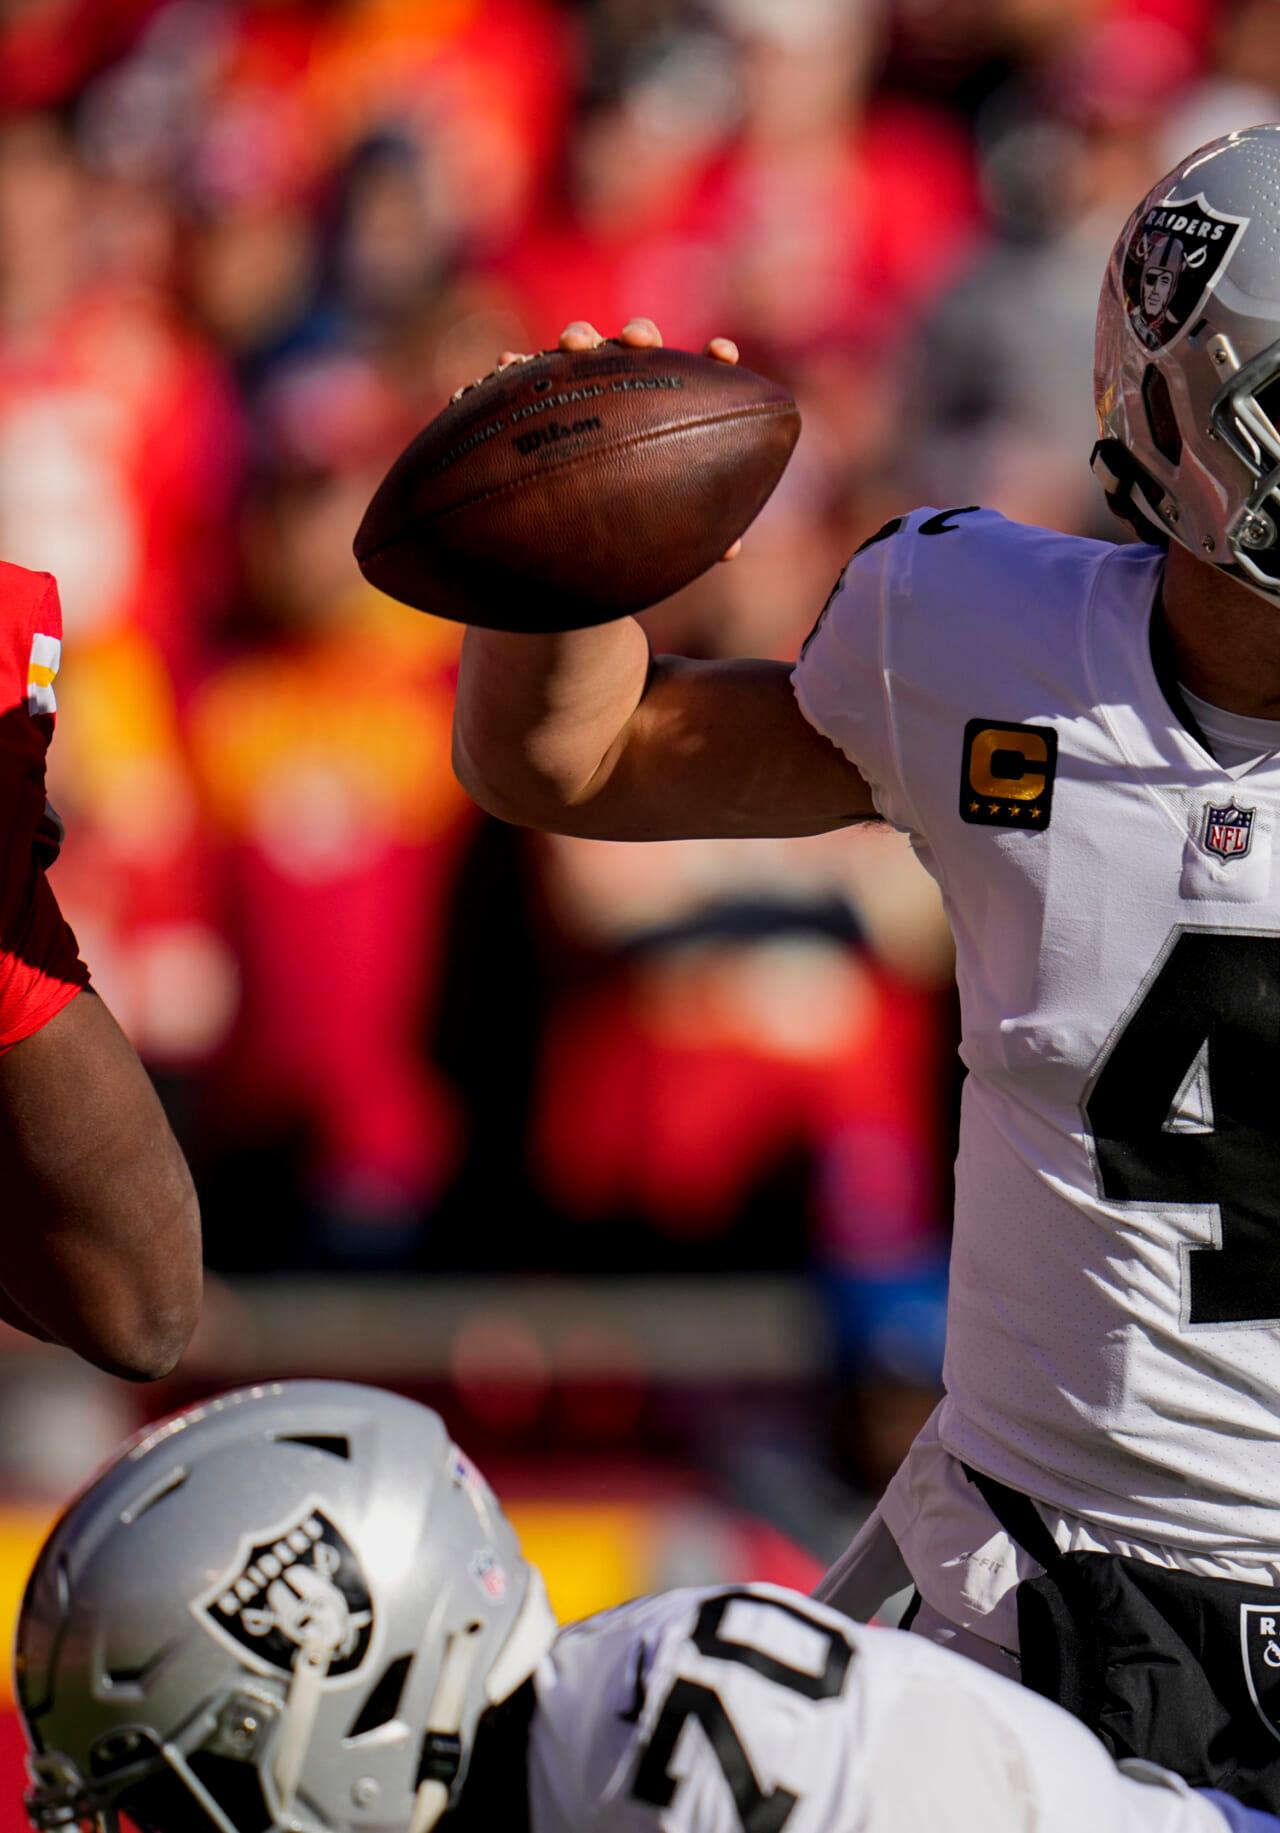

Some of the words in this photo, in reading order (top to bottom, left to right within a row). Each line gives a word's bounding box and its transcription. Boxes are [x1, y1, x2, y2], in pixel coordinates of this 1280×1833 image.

[1145, 210, 1226, 241] RAIDERS
[431, 421, 506, 475] NATIONAL
[511, 386, 605, 423] FOOTBALL
[611, 376, 683, 393] LEAGUE
[513, 416, 602, 454] Wilson
[969, 728, 1048, 801] C
[1210, 825, 1245, 853] NFL
[631, 1592, 856, 1832] 70
